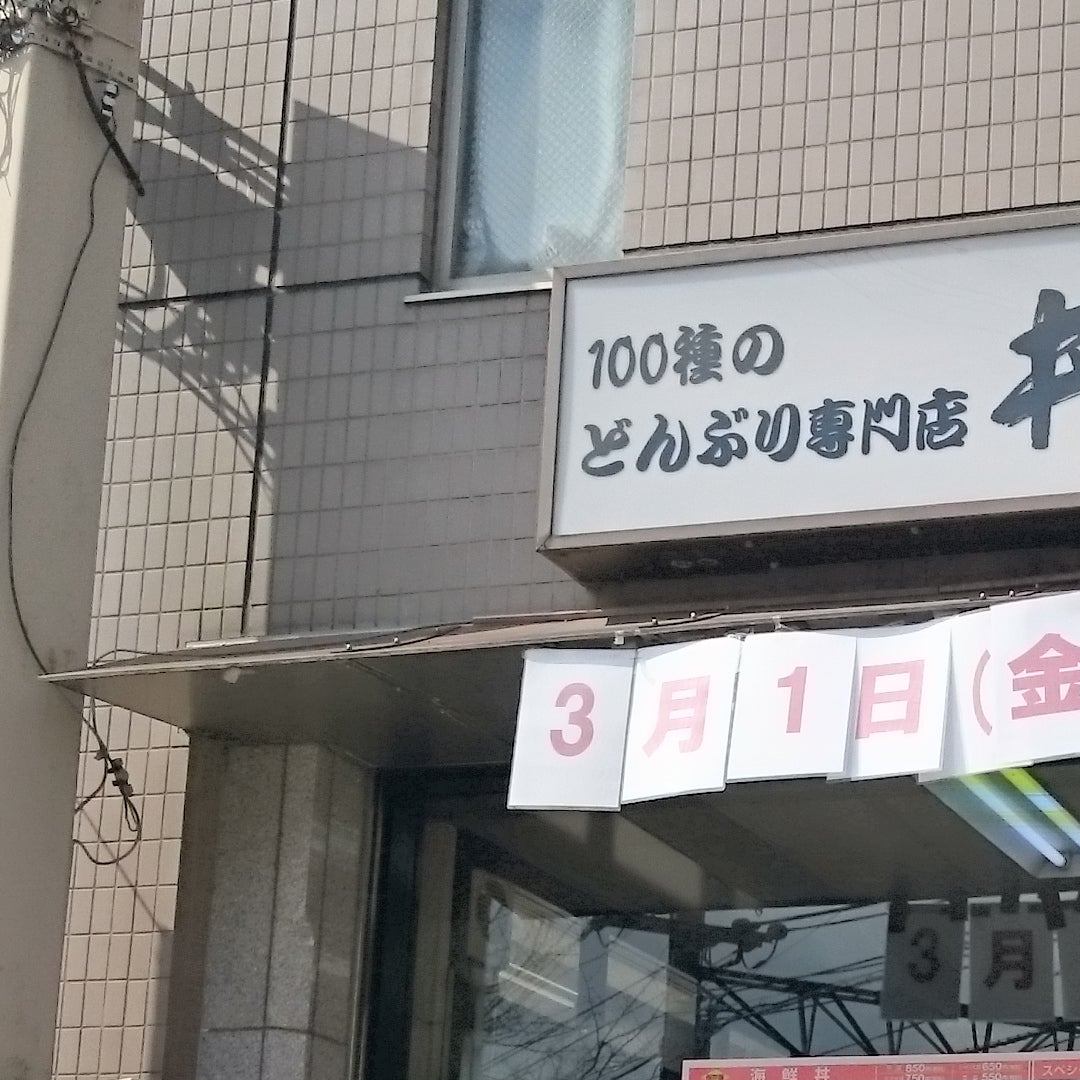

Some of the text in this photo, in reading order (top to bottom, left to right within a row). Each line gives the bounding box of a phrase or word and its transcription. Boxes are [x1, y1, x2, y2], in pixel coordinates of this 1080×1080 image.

[587, 322, 785, 389] 100種の
[581, 389, 969, 478] どんぶり専門店
